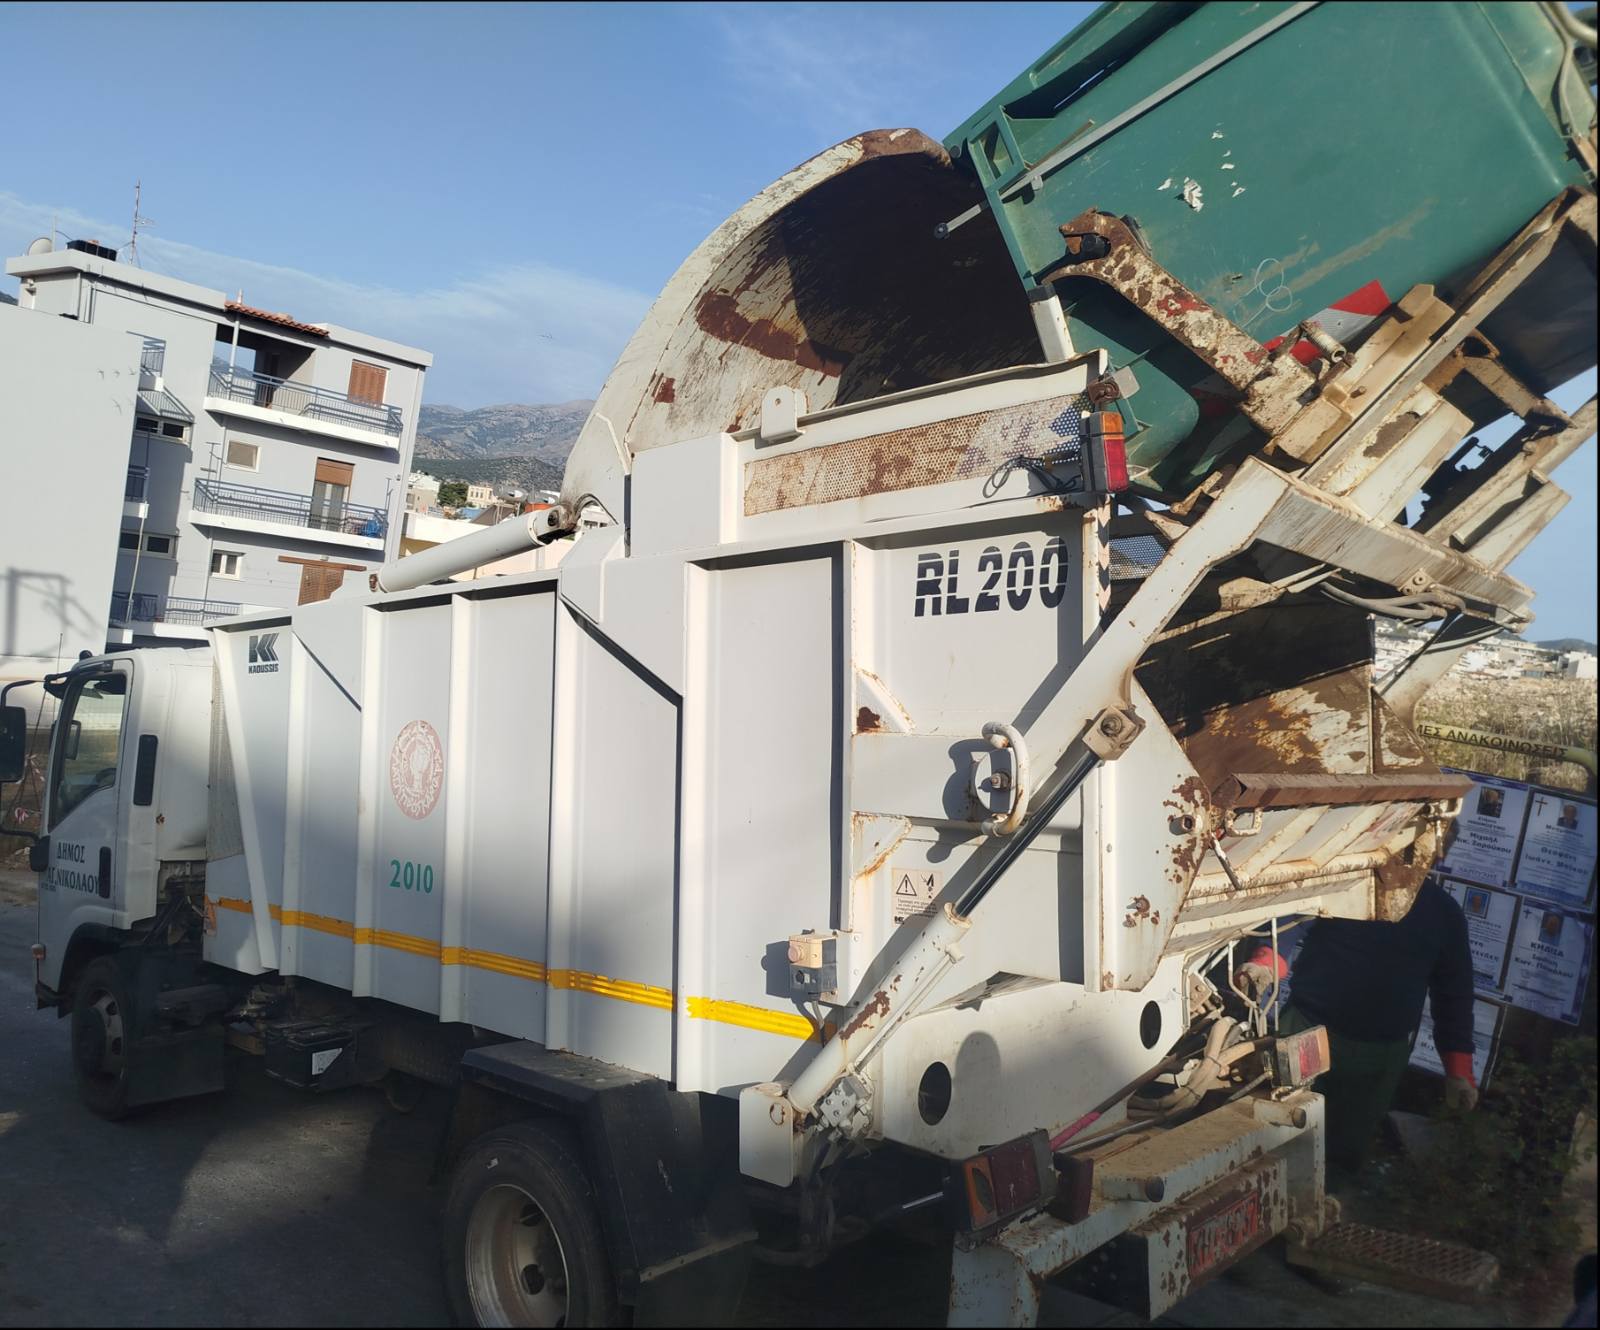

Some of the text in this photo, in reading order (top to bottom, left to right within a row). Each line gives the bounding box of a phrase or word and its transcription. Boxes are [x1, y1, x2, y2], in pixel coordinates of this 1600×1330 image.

[914, 537, 1069, 617] RL200
[248, 663, 279, 674] KAOUSSIS
[1446, 728, 1569, 756] ΑΝΑΚΟΙΝΩΣΕΙΣ
[56, 842, 85, 864] ΔΗΜΟΣ
[389, 859, 433, 894] 2010
